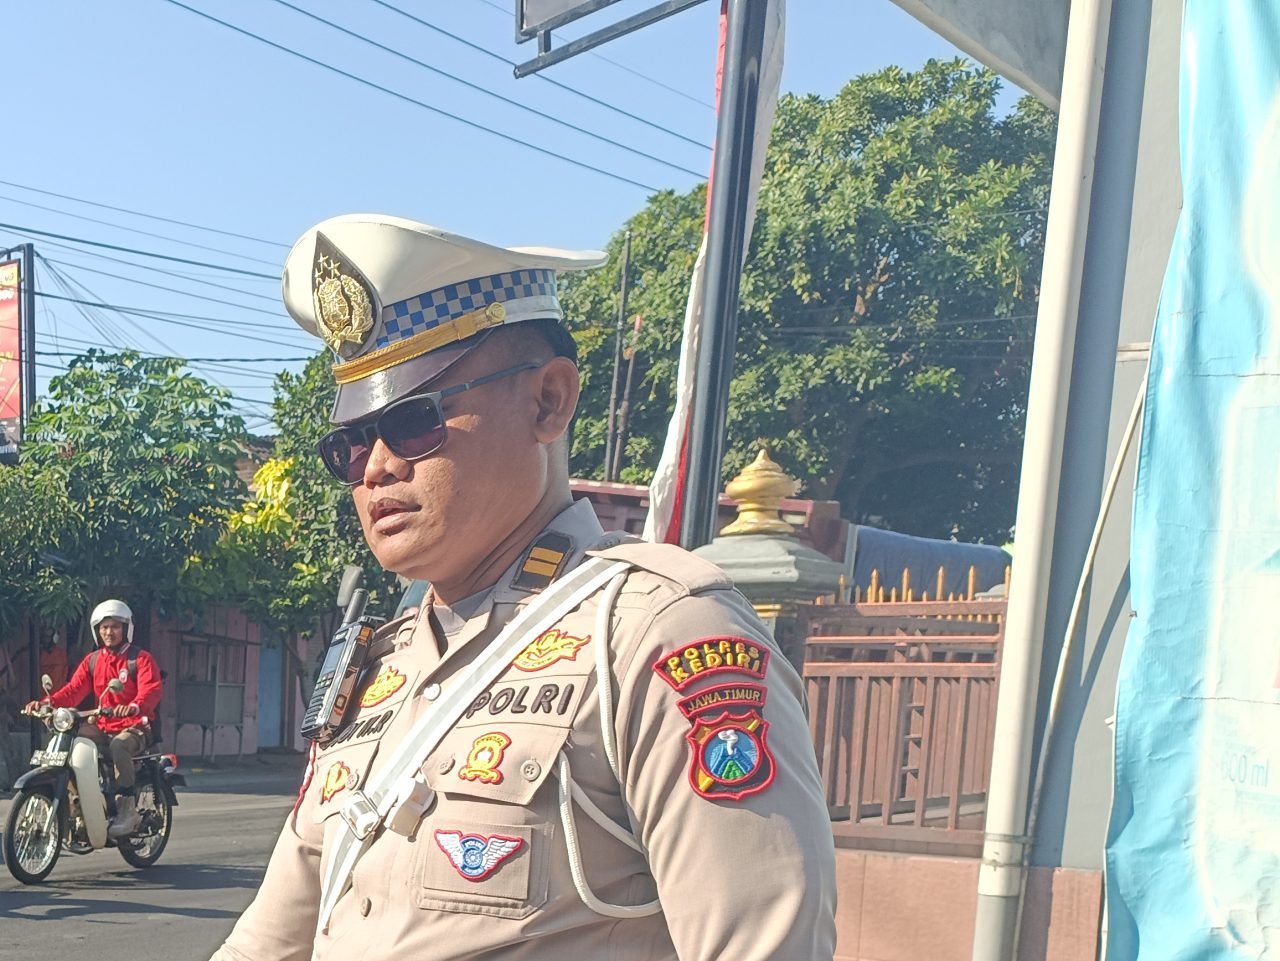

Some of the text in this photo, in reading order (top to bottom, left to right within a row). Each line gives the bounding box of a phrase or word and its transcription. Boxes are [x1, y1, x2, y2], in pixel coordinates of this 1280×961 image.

[668, 641, 760, 670] POLRES
[671, 653, 760, 684] KEDIRI
[466, 683, 575, 719] POLRI
[687, 688, 761, 712] JAWA TIMUR
[1251, 757, 1270, 788] ml
